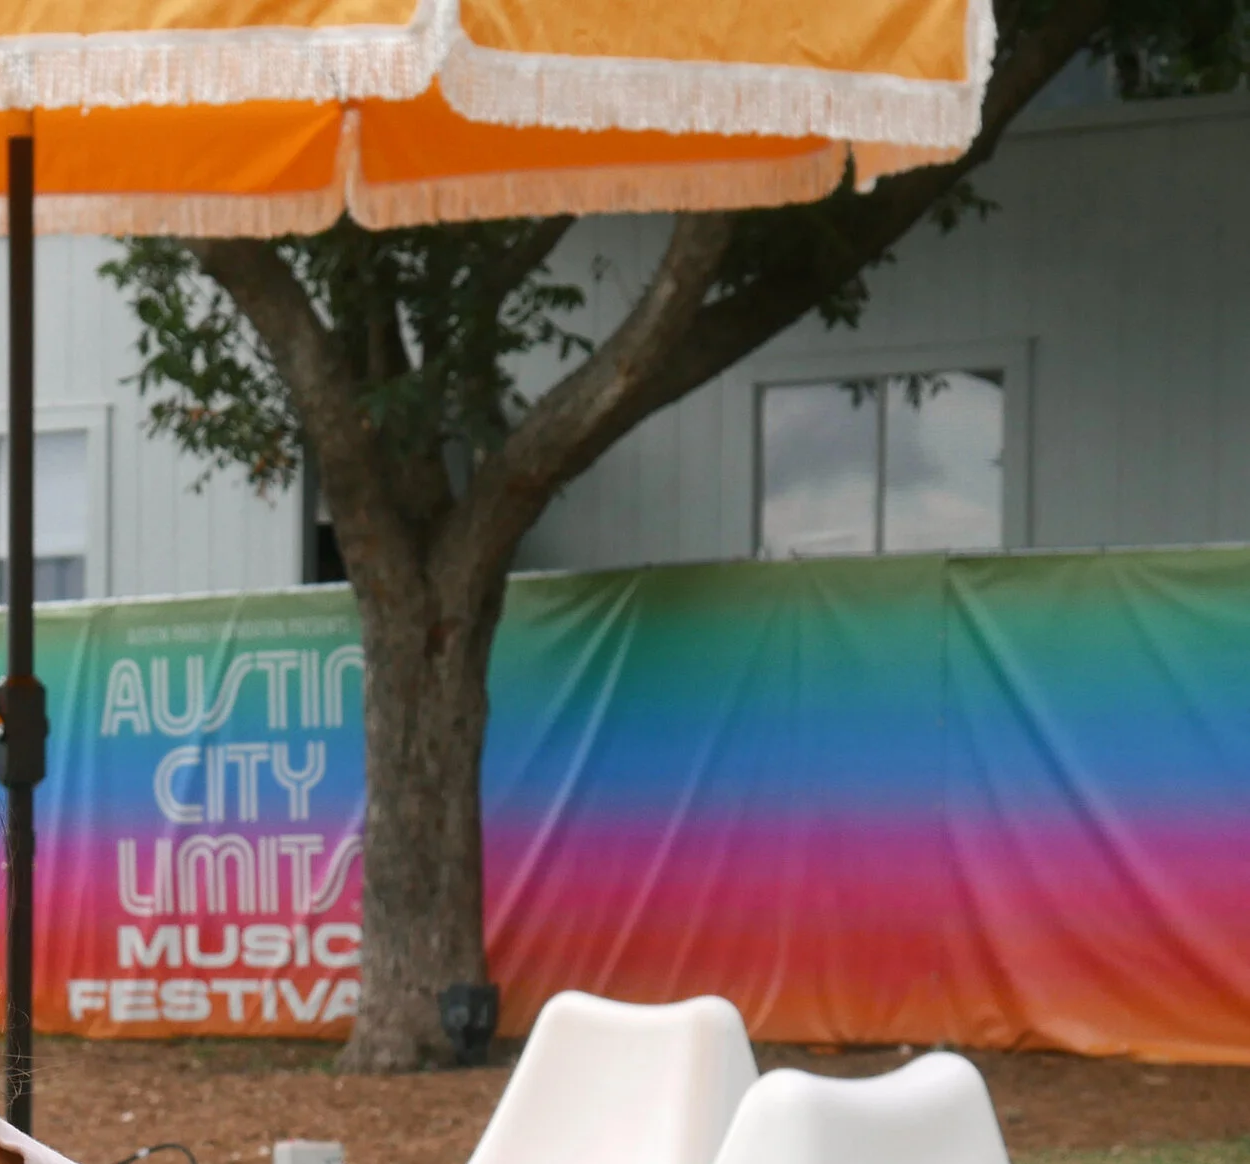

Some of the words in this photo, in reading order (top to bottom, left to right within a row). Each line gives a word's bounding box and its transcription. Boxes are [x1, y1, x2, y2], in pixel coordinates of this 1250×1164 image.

[154, 741, 326, 824] CITY
[118, 834, 363, 917] LIMITS
[118, 922, 362, 969] MUSIC
[67, 978, 359, 1022] FESTIVA
